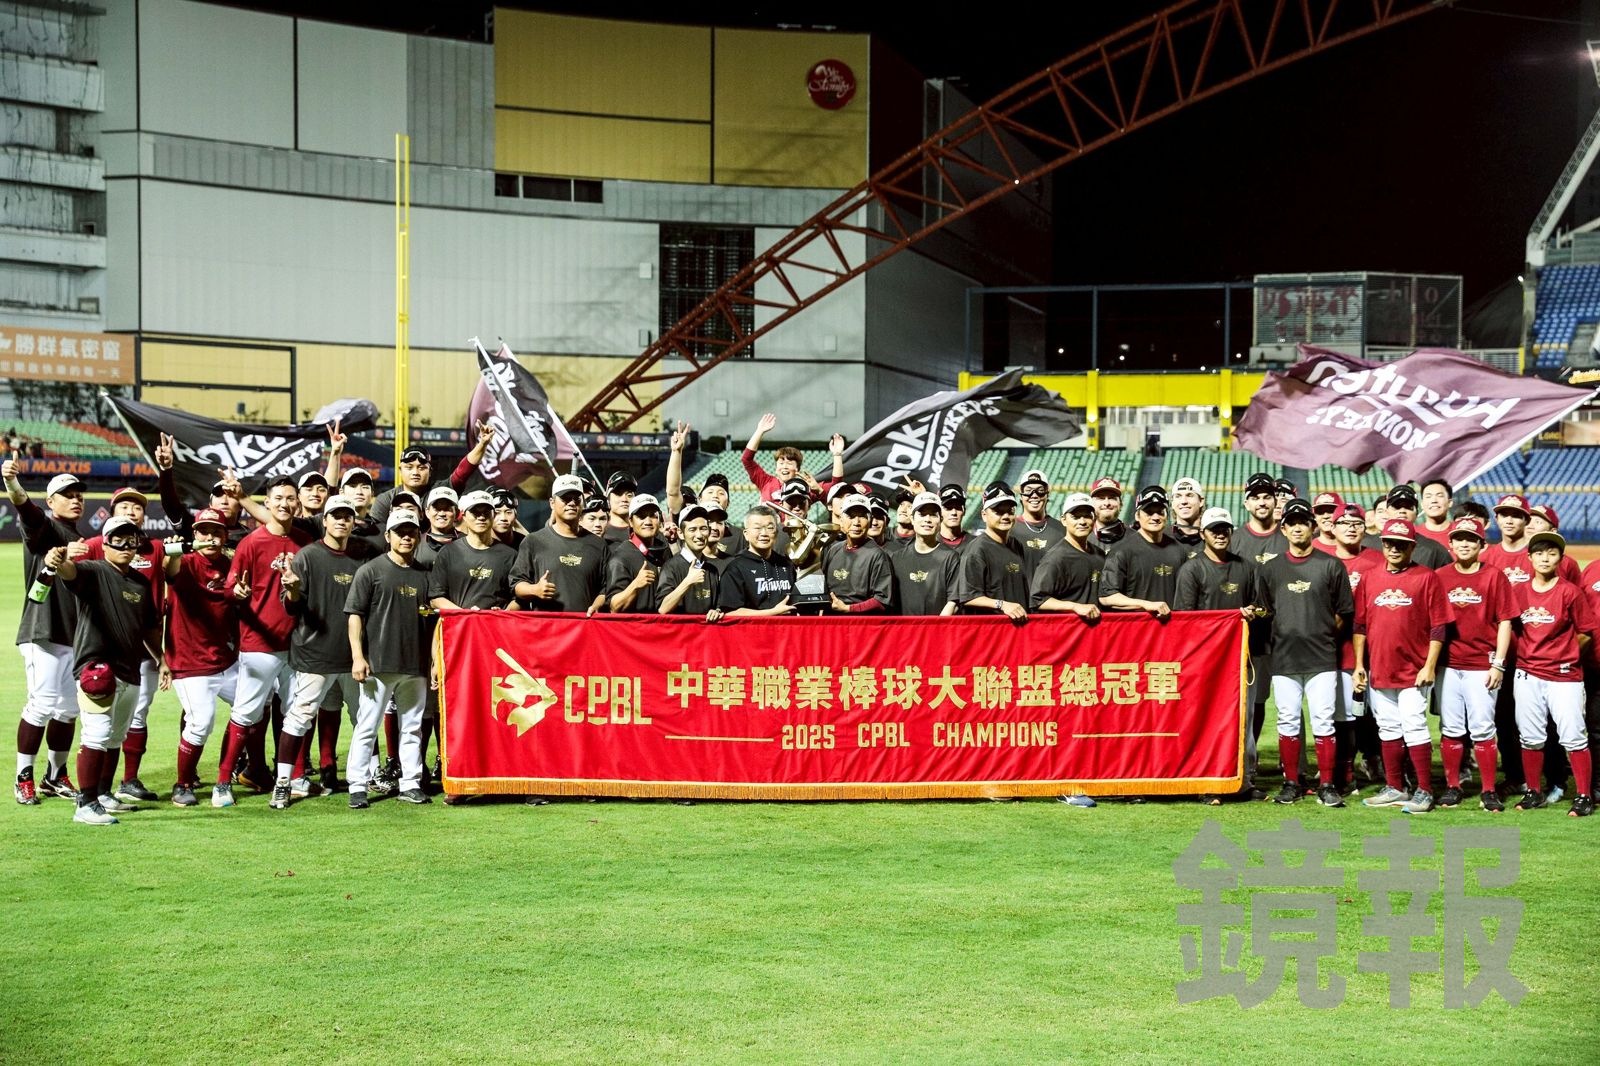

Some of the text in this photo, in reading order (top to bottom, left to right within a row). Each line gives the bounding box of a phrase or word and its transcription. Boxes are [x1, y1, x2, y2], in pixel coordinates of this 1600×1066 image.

[32, 460, 91, 474] MAXXIS
[565, 676, 652, 725] CPBL
[666, 661, 1182, 711] 中華職業棒球大聯盟總冠軍
[781, 721, 1059, 750] 2025 CPBL CHAMPIONS
